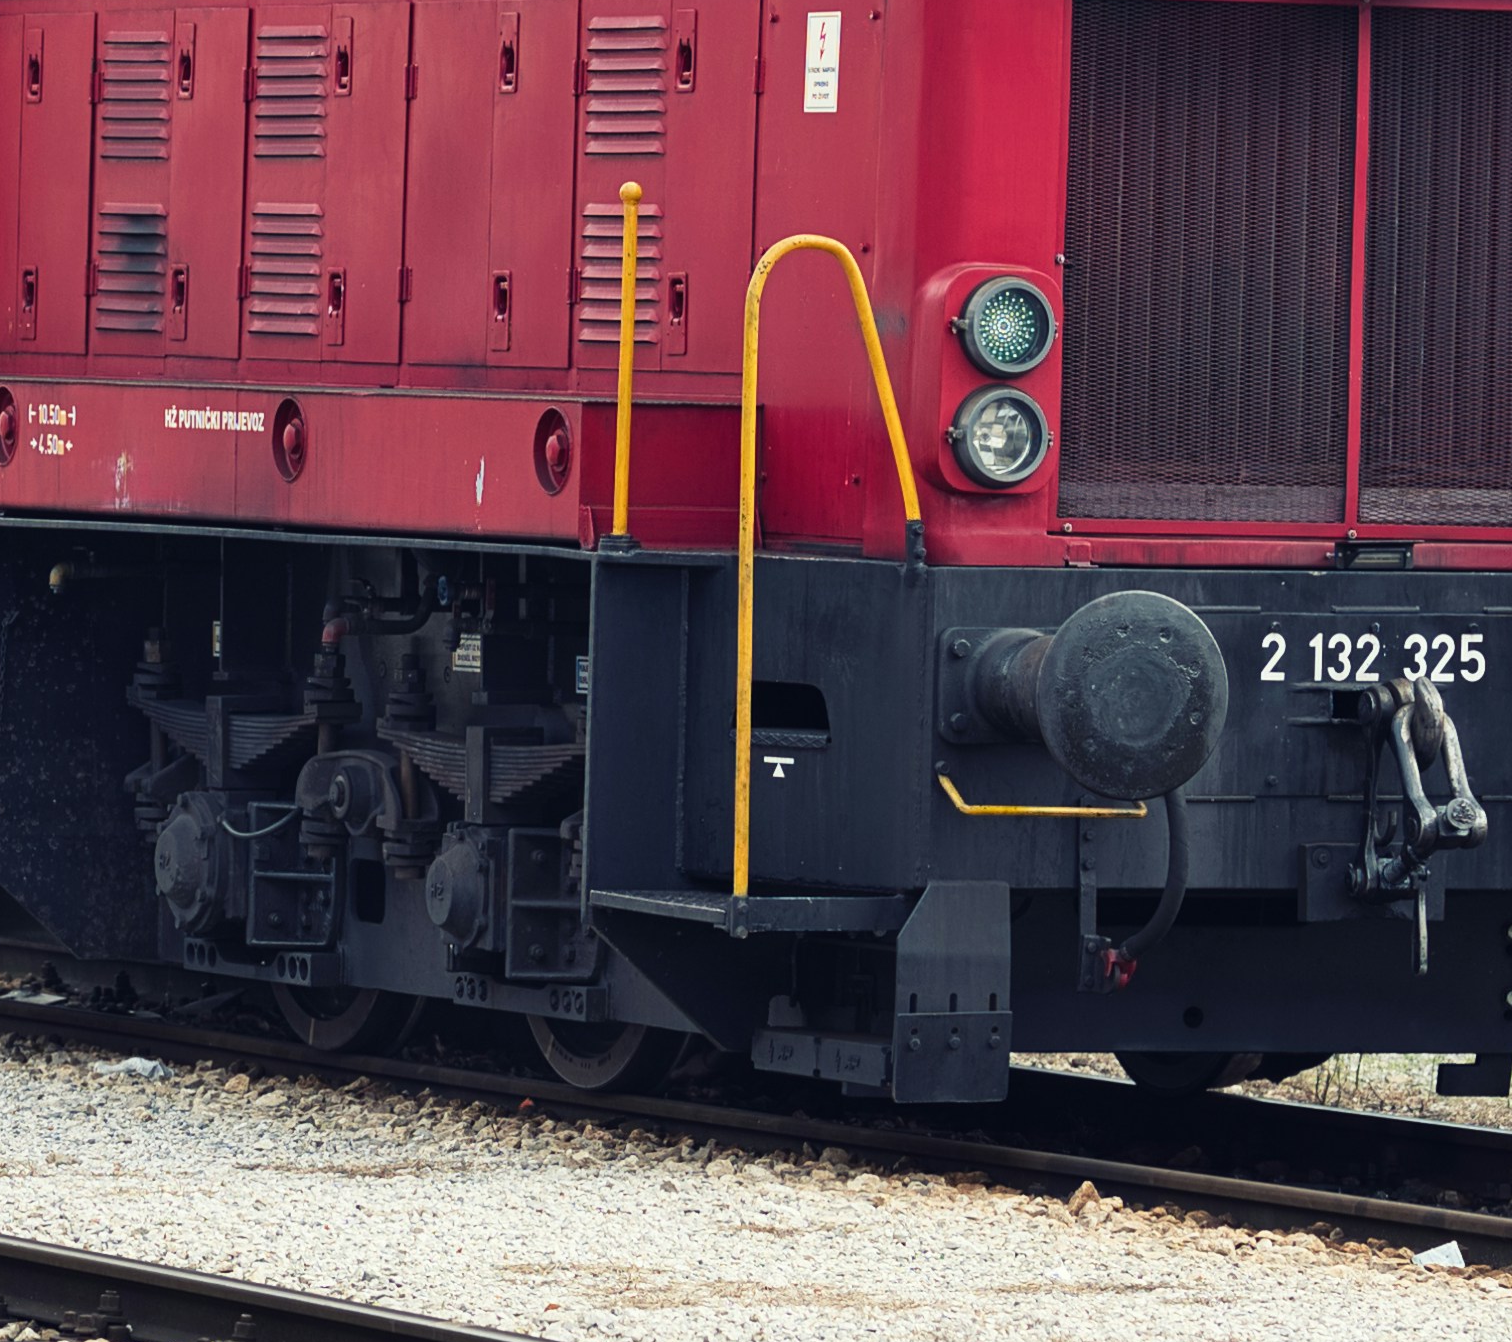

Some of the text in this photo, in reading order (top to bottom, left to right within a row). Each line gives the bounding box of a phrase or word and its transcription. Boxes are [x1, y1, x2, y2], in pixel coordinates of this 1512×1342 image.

[165, 405, 265, 432] HŽ PUTNIČKI PRIJEVOZ
[1260, 632, 1486, 682] 2 132 325
